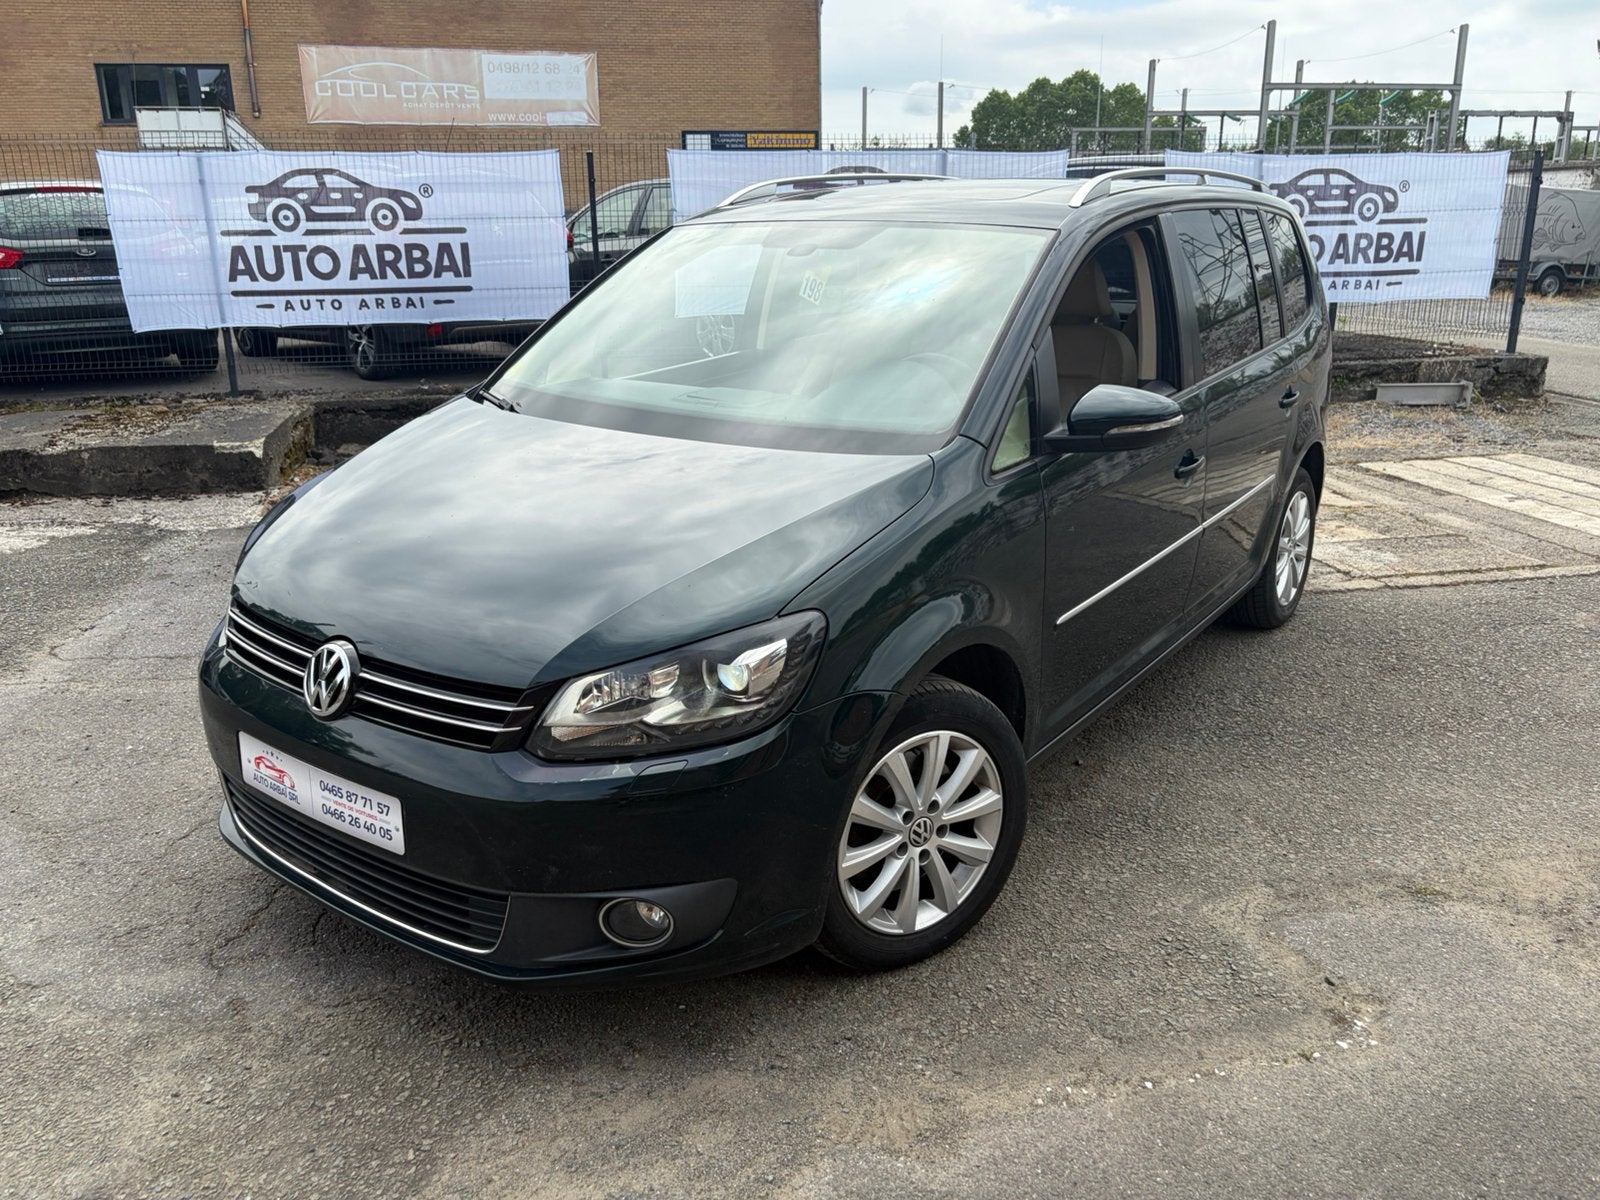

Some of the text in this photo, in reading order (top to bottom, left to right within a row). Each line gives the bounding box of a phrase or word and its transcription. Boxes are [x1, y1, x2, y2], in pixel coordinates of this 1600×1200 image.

[544, 63, 560, 75] 68
[228, 242, 472, 282] AUTO ARBAI
[1327, 231, 1426, 265] ARBAI
[802, 276, 824, 302] 198
[1327, 279, 1380, 291] ARBAI
[284, 296, 425, 312] AUTO ARBAI
[253, 772, 301, 805] AUTO ARBAI SRL
[319, 779, 391, 817] 0465 87 71 57
[321, 803, 393, 841] 0466 26 40 05
